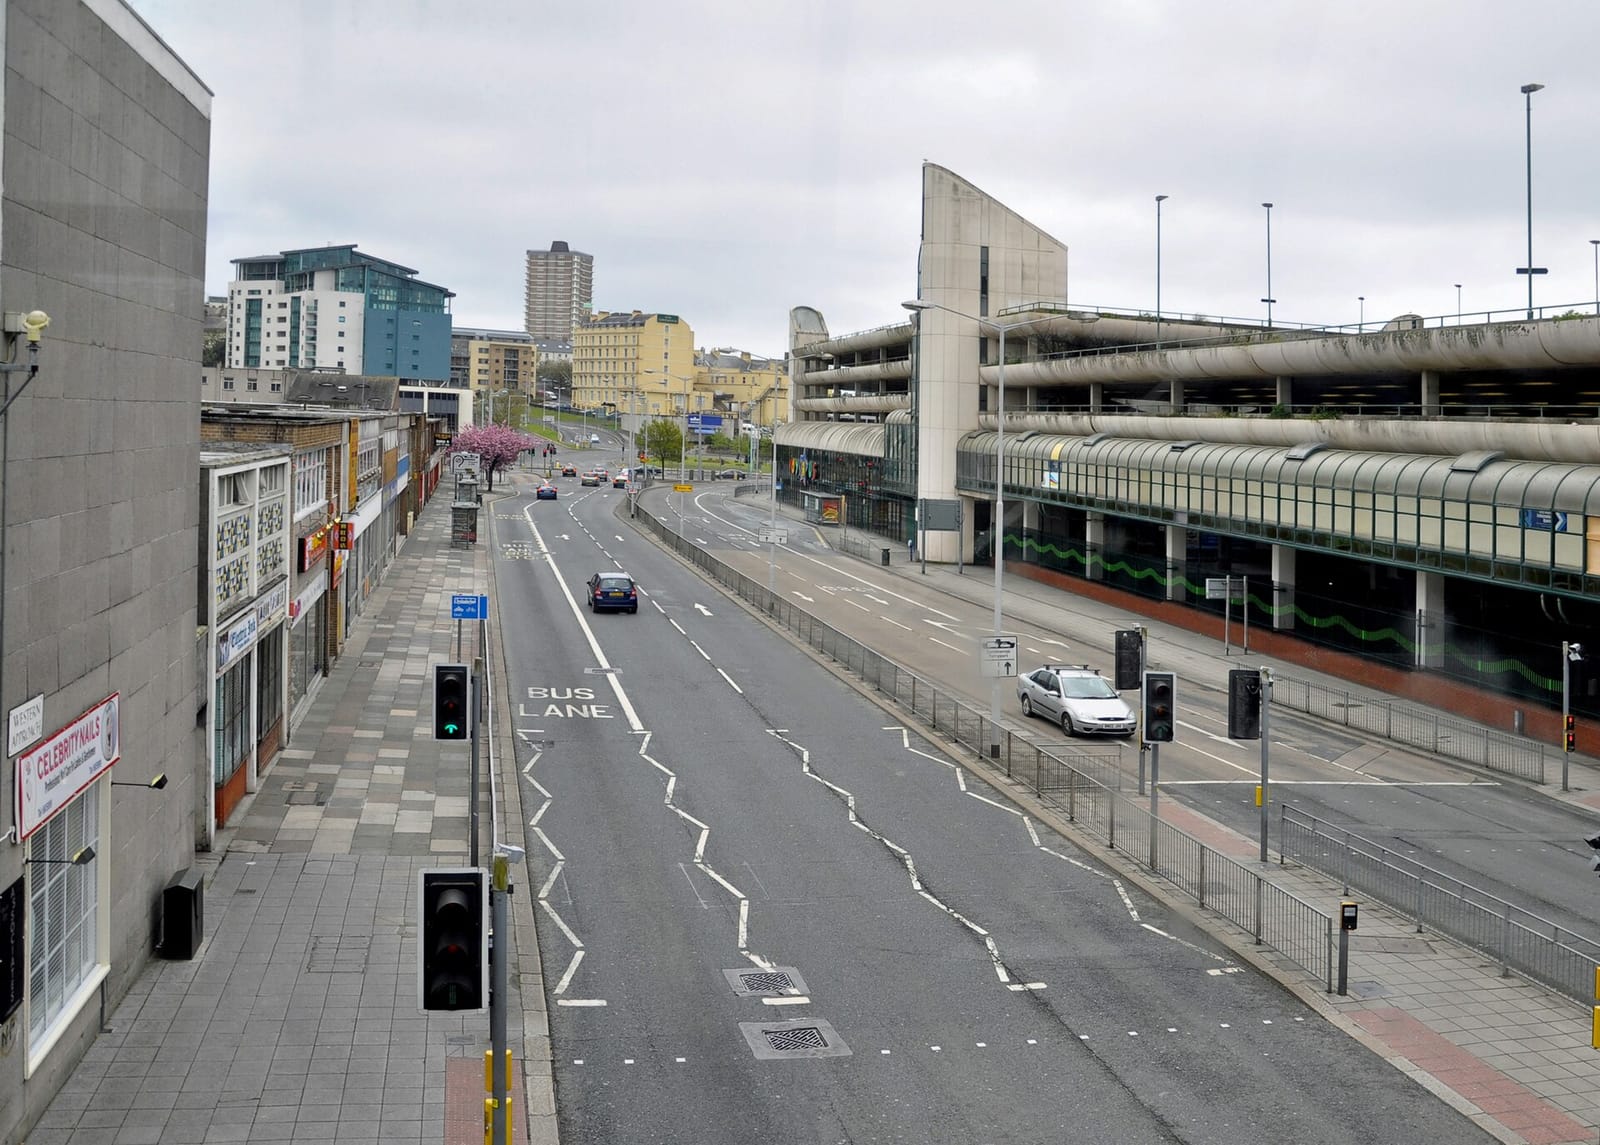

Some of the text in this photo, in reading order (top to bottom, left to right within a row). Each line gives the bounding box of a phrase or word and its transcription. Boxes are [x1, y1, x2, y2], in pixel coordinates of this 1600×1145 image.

[527, 687, 595, 700] BUS
[13, 704, 41, 727] WESTERN
[518, 703, 614, 719] LANE
[11, 720, 41, 747] APPROACH
[37, 731, 80, 780] CELEBRITY
[79, 717, 100, 746] NAILS
